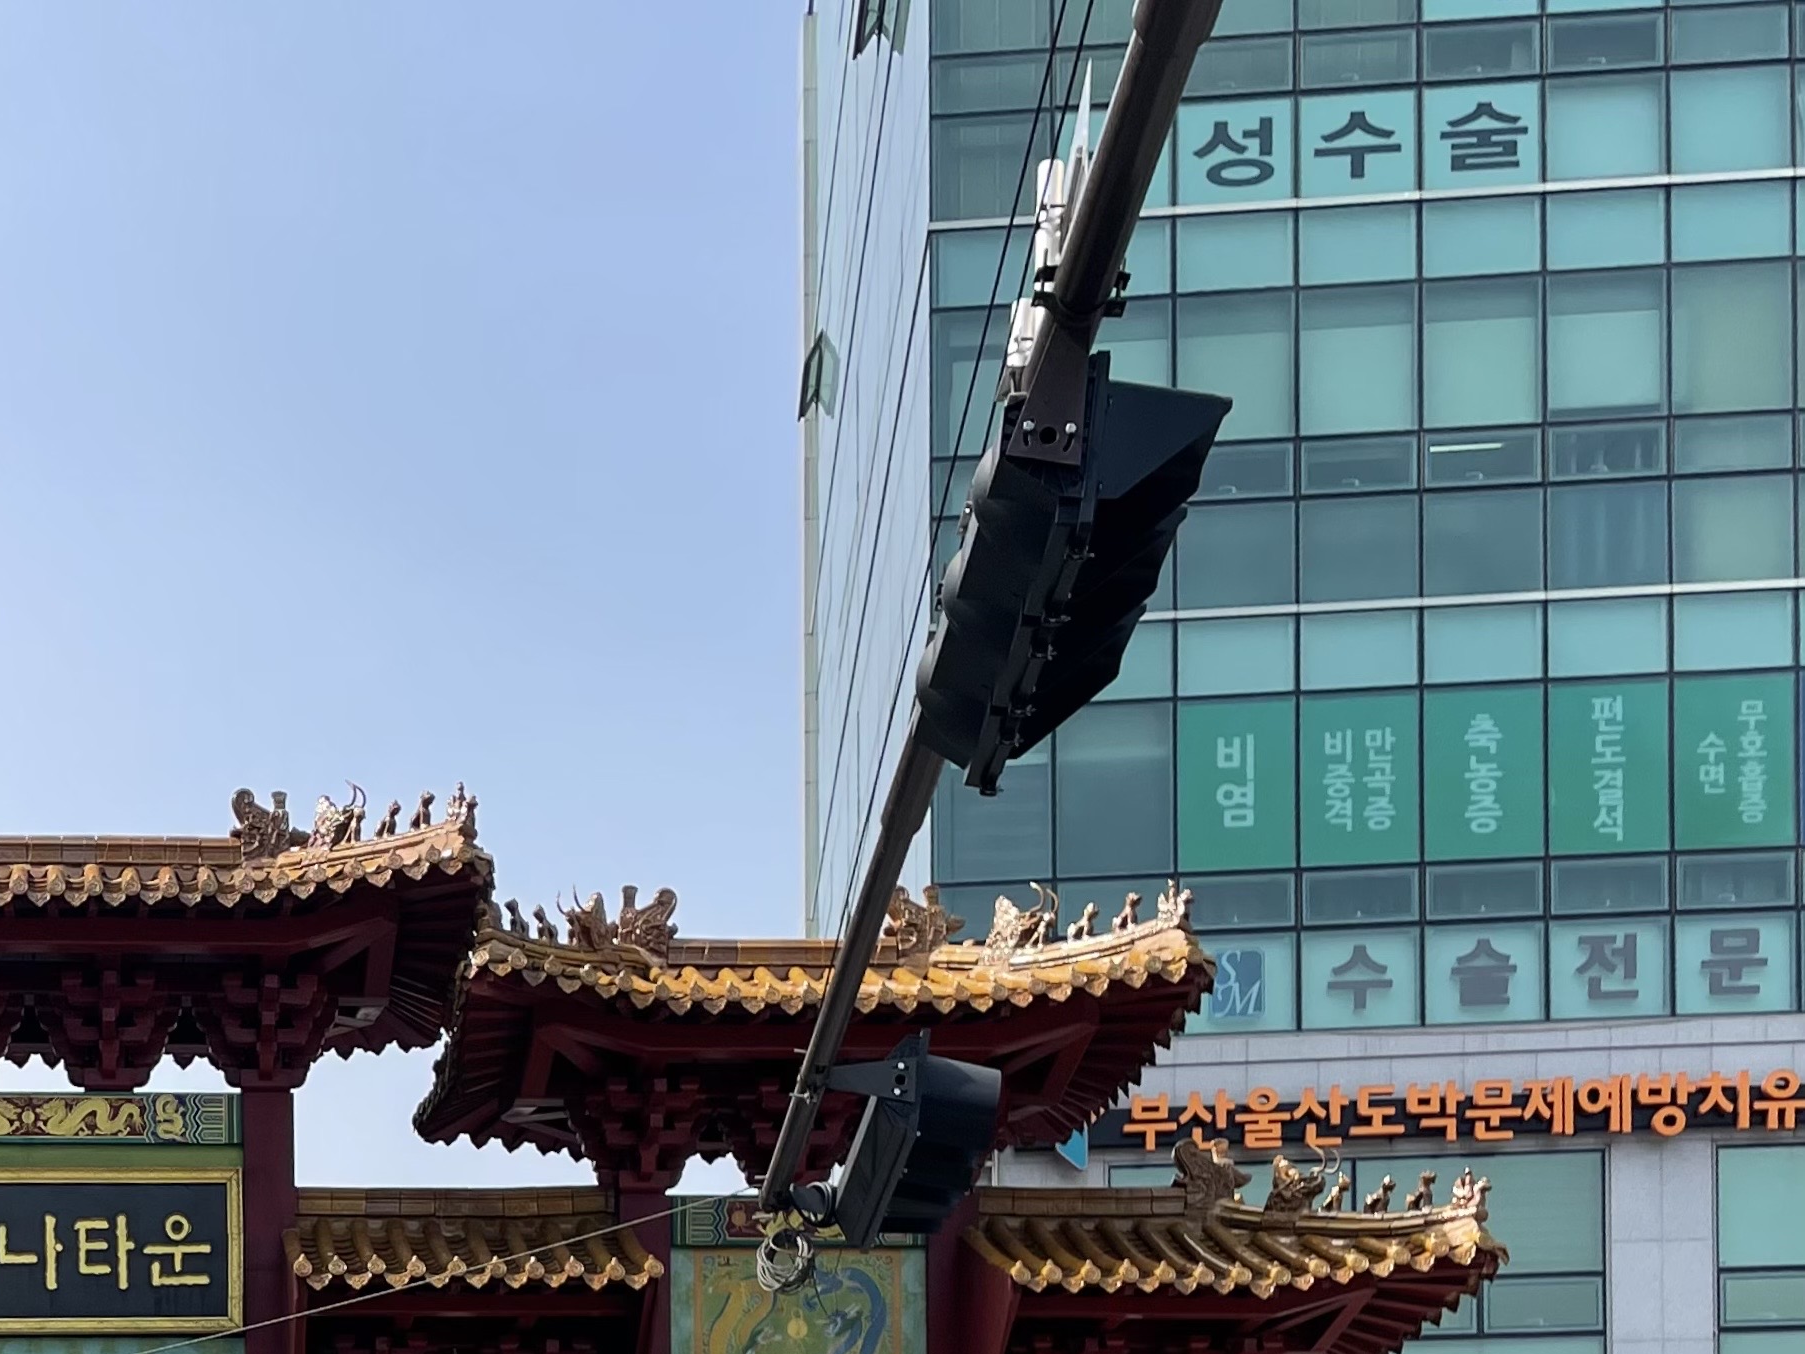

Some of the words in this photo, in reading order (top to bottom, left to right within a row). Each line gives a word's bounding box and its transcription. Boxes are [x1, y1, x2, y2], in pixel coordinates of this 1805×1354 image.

[1216, 734, 1255, 829] 비염
[1323, 728, 1355, 833] 비중격
[1363, 727, 1395, 832] 만곡증
[1464, 713, 1503, 834] 축농증
[1591, 696, 1626, 841] 편도결석
[1697, 731, 1728, 795] 수면
[1736, 700, 1768, 824] 무호흡증
